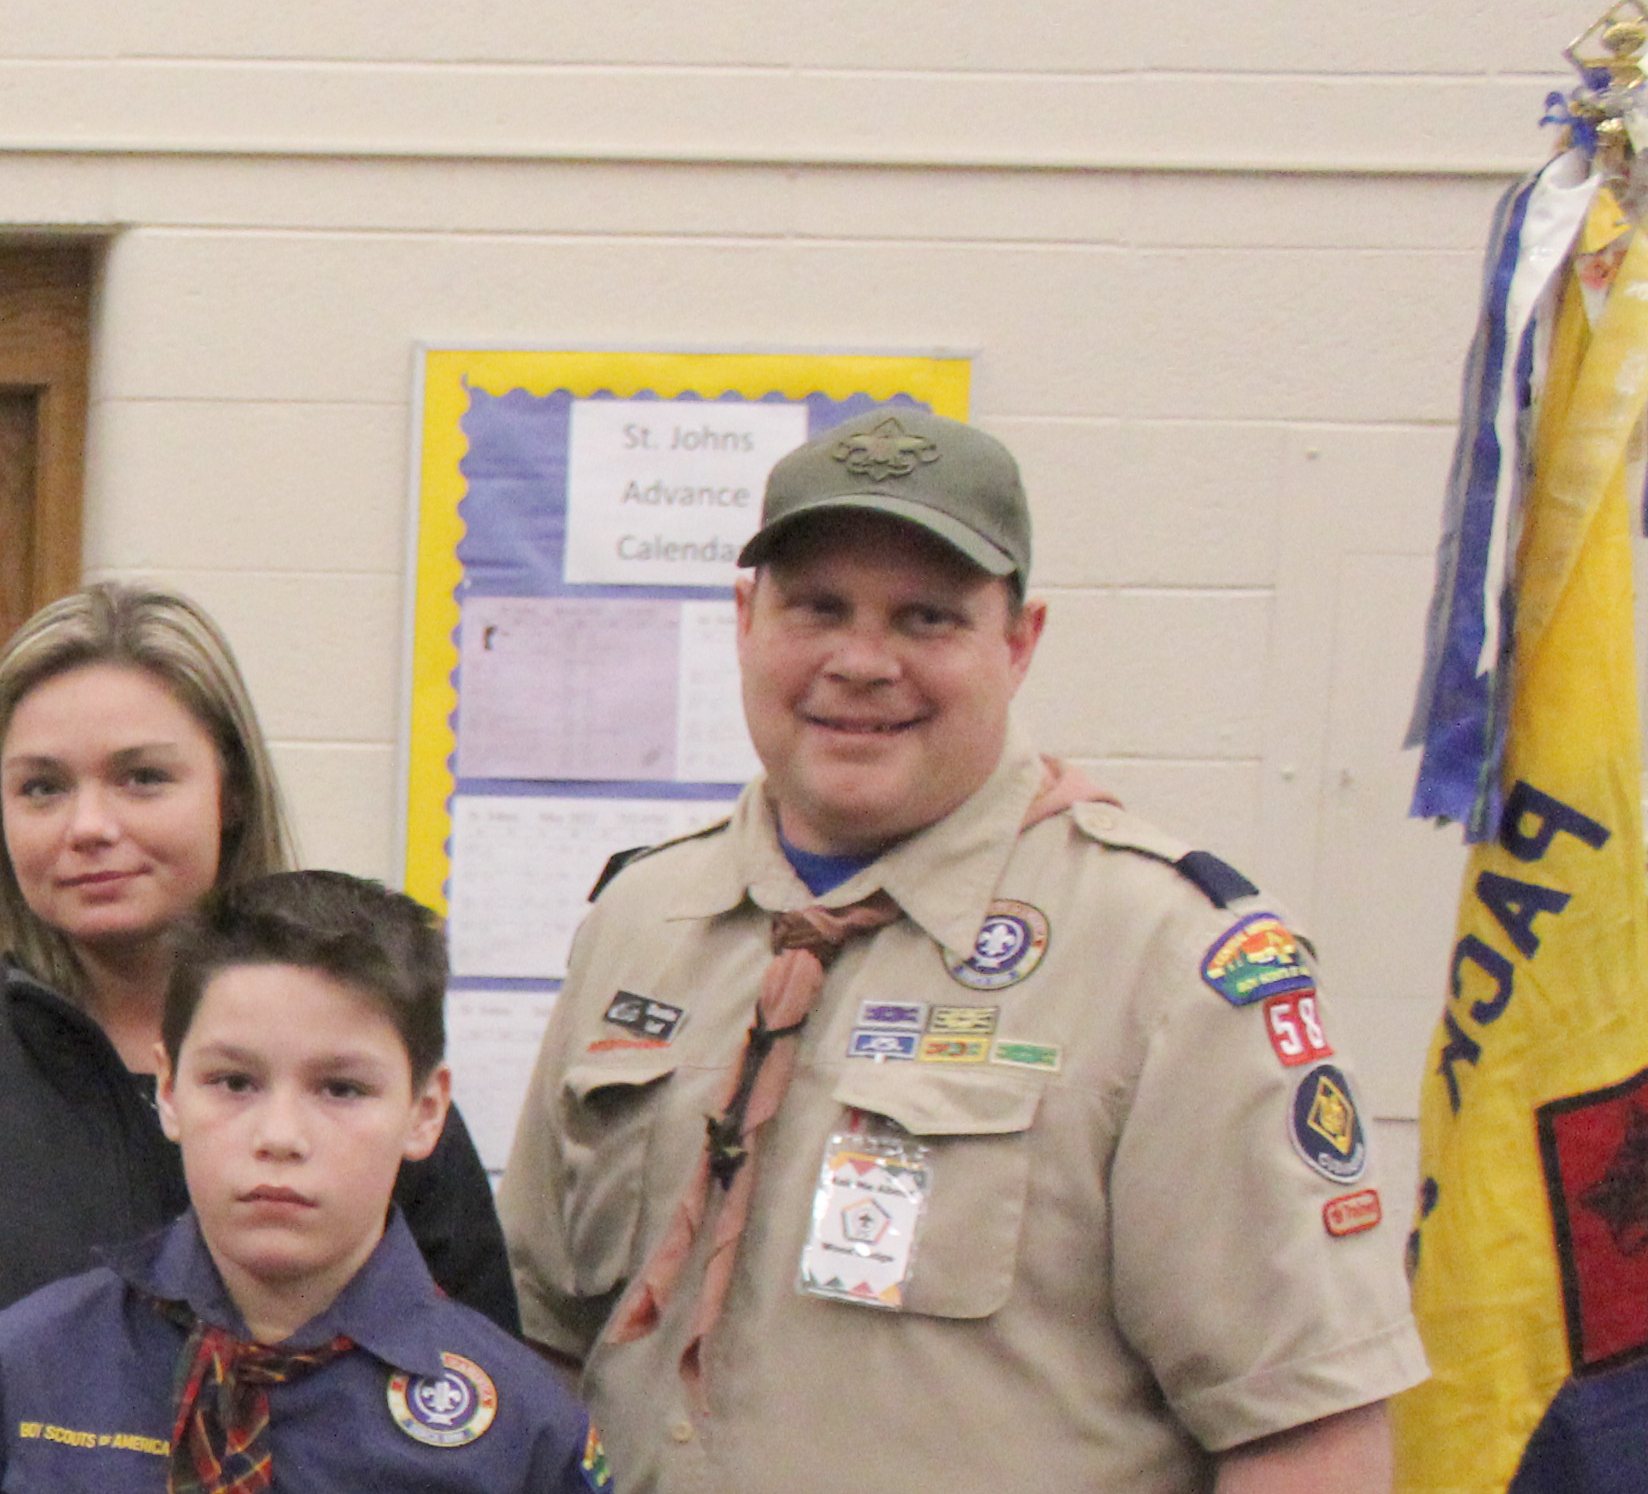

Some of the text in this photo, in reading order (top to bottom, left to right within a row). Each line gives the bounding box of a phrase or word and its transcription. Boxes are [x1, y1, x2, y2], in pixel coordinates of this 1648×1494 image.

[621, 423, 754, 452] St. Johns
[619, 479, 751, 508] Advance
[617, 534, 746, 562] Calenda
[1270, 998, 1326, 1055] 58
